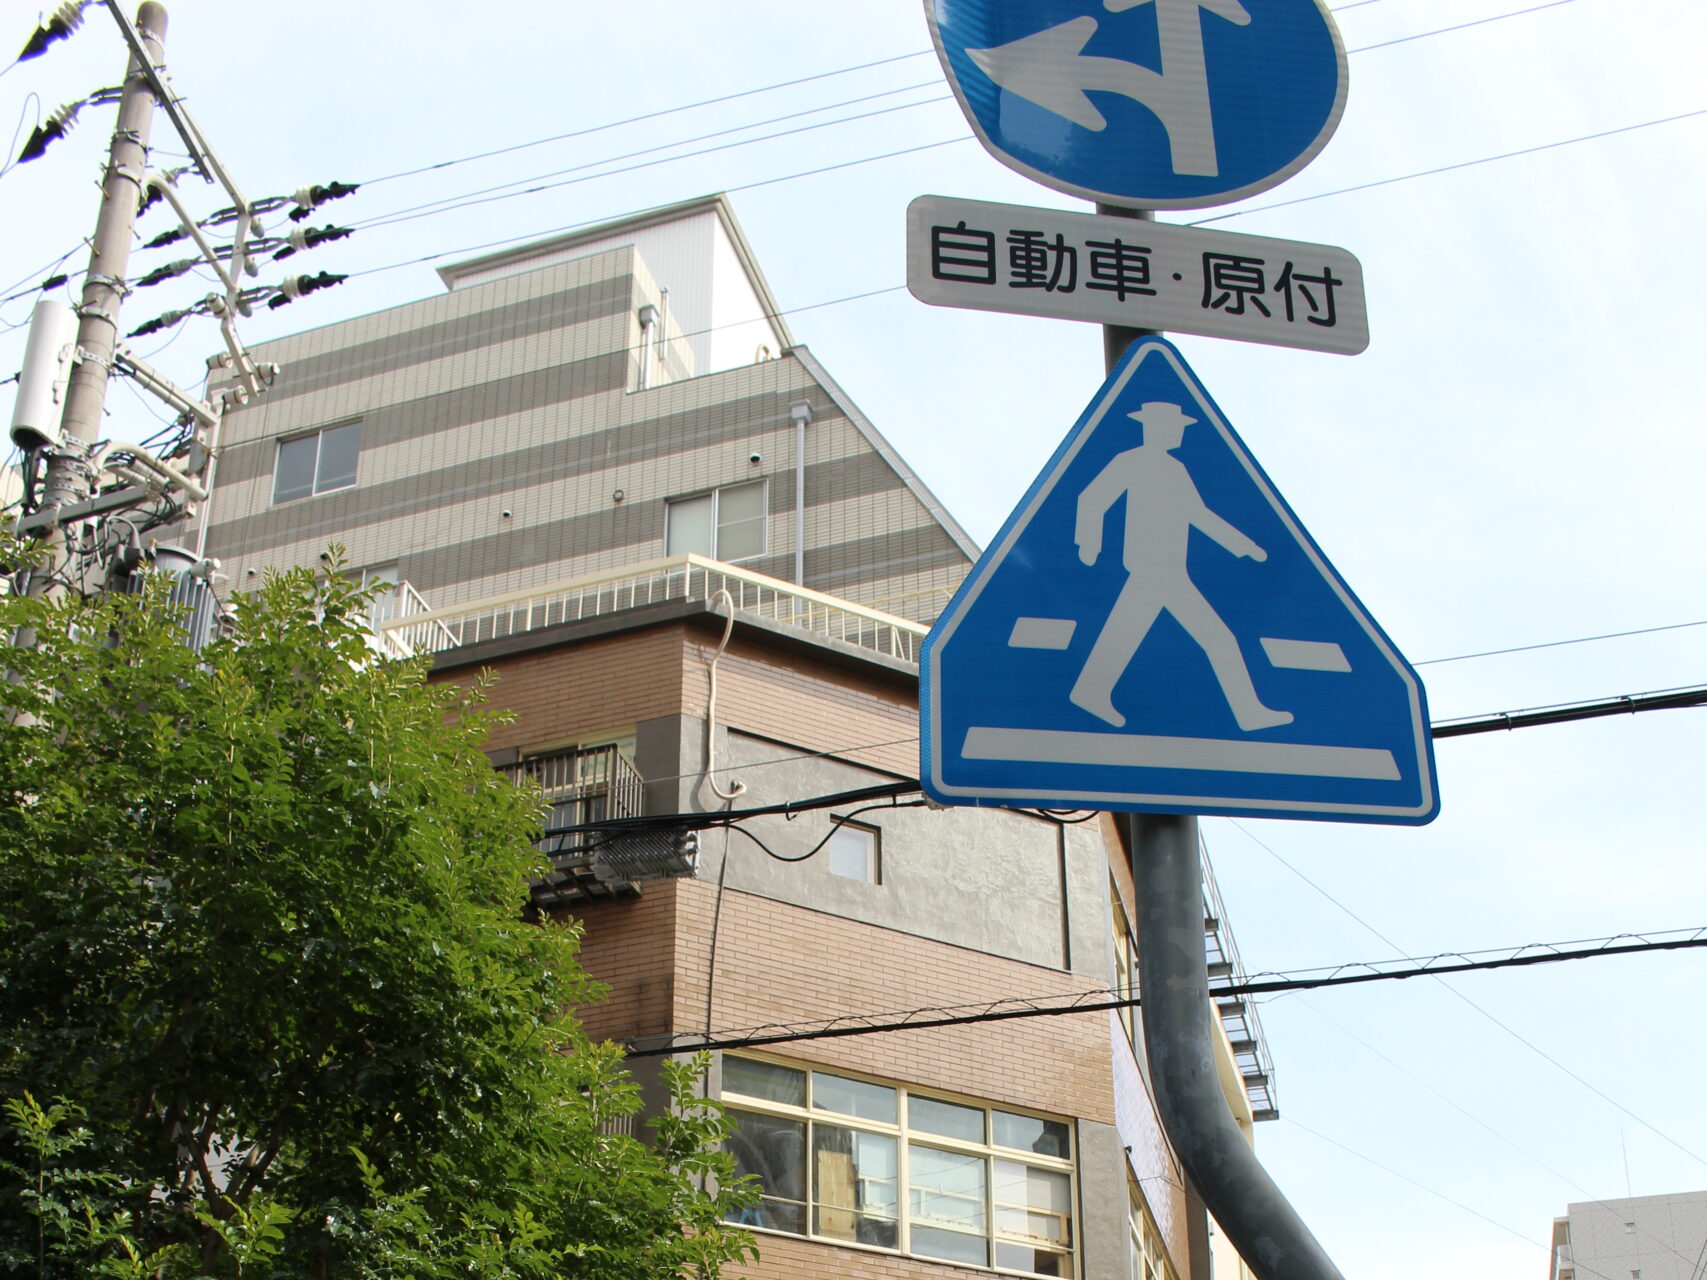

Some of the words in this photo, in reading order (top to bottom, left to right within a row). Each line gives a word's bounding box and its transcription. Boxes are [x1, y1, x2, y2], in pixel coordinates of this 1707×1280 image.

[931, 221, 1343, 327] 自動車・原付
